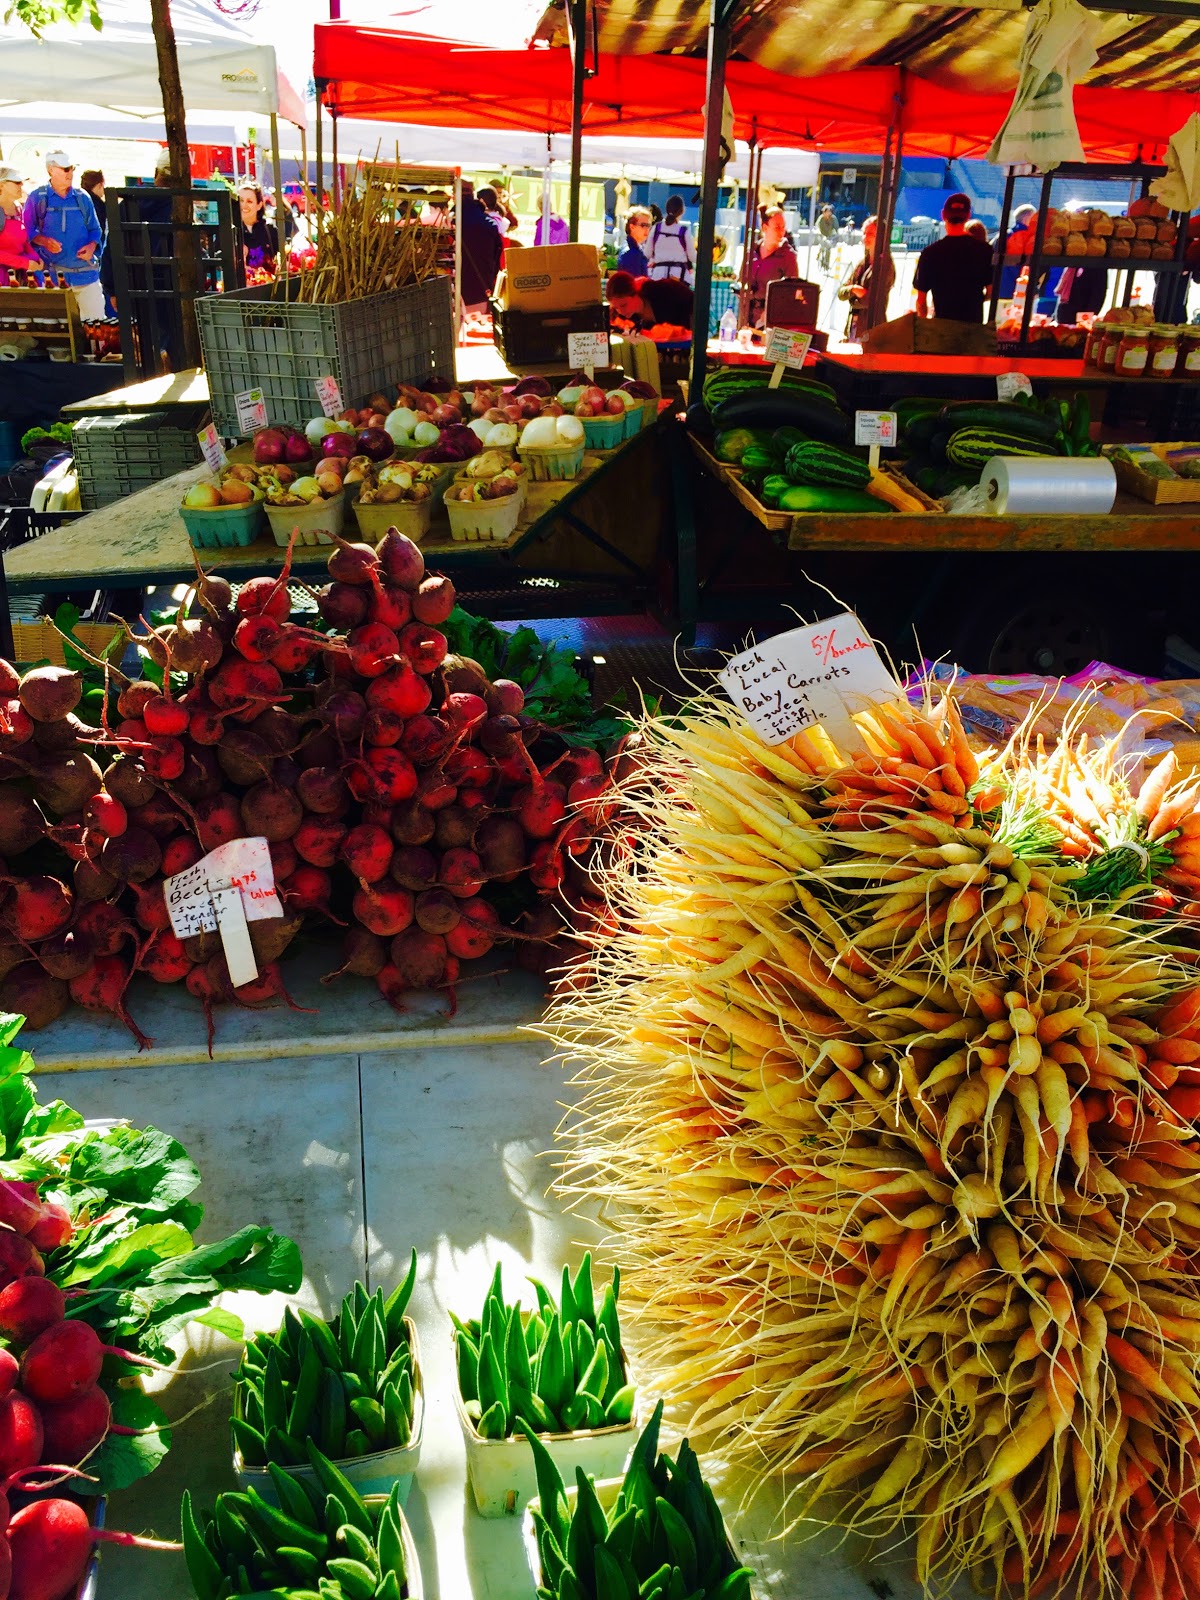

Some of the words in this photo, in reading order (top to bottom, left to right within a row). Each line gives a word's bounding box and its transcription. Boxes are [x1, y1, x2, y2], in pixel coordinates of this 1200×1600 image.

[739, 658, 787, 690] Local
[742, 690, 782, 712] Baby
[787, 666, 851, 689] Carrots
